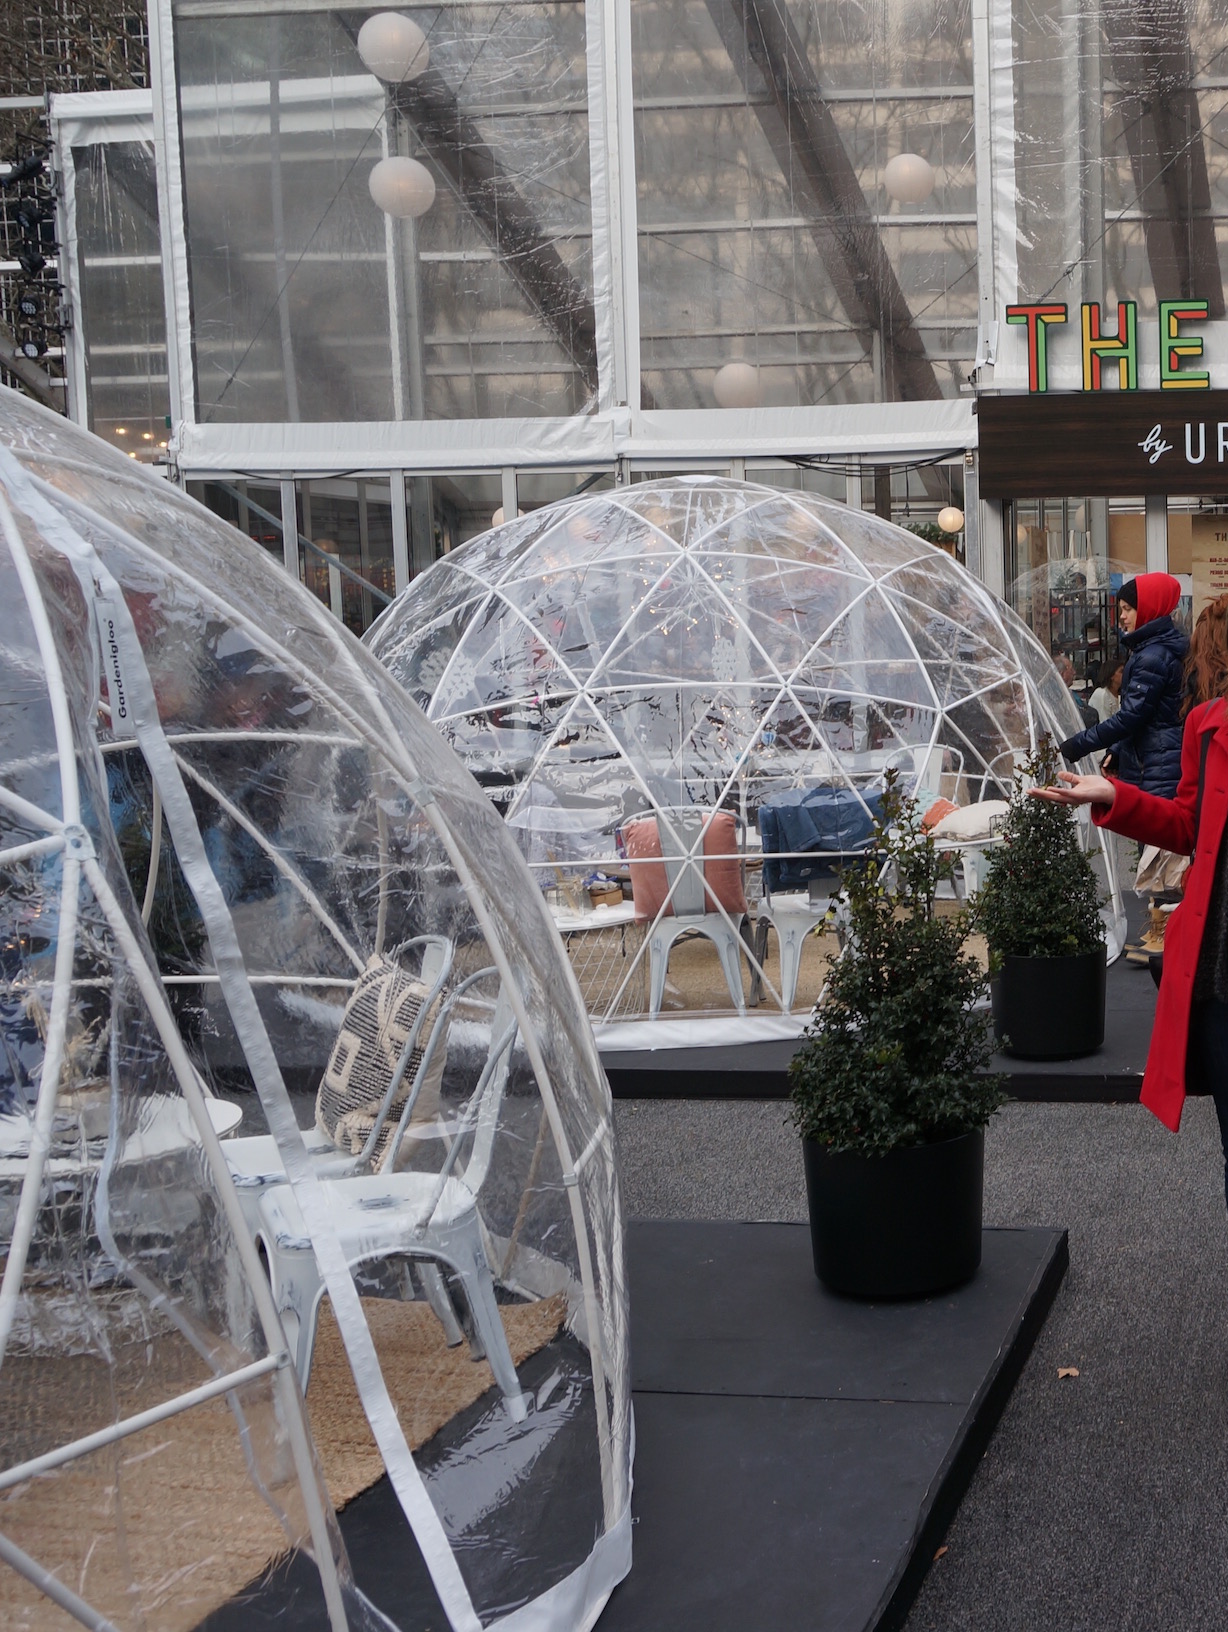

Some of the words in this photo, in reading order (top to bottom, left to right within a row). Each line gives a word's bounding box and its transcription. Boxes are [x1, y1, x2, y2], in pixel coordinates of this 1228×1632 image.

[1006, 298, 1211, 393] THE
[1137, 423, 1174, 464] by
[107, 619, 127, 719] Gardenigloo
